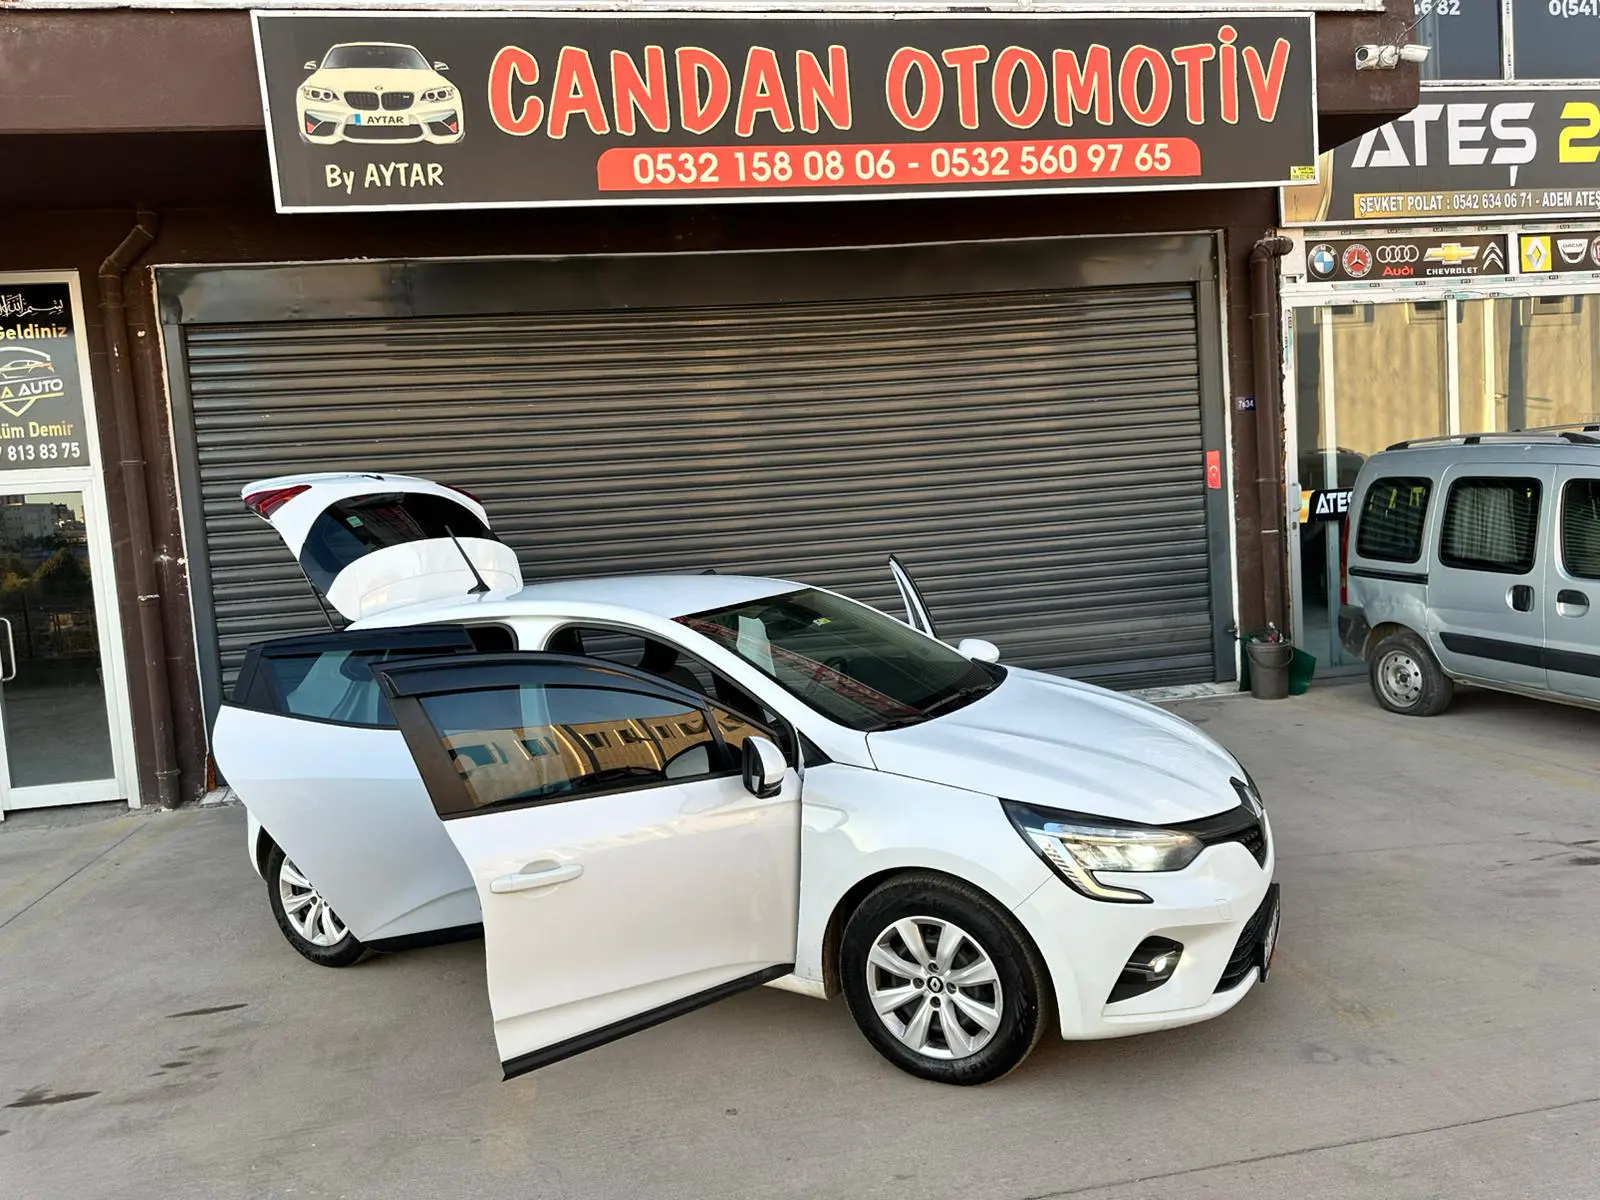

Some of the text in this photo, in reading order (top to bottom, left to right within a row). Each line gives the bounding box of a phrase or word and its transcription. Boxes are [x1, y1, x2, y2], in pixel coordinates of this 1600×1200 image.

[1437, 0, 1460, 15] 82
[1549, 0, 1600, 18] 0(541
[488, 24, 1290, 139] CANDAN OTOMOTİV
[366, 115, 404, 124] AYTAR
[1351, 102, 1537, 187] ATEŞ
[633, 153, 719, 184] 0532
[735, 151, 792, 182] 158
[803, 149, 844, 181] 08
[855, 148, 896, 180] 06
[930, 146, 1009, 178] 0532
[1020, 144, 1078, 176] 560
[1088, 143, 1123, 173] 97
[1135, 143, 1171, 172] 65
[325, 162, 444, 194] By AYTAR
[1359, 196, 1404, 217] ŞEVKET
[1407, 195, 1443, 211] POLAT
[1453, 194, 1480, 210] 0542
[1482, 194, 1503, 209] 634
[1504, 193, 1517, 208] 06
[1520, 193, 1532, 208] 71
[1541, 191, 1573, 207] ADEM
[1426, 266, 1478, 276] CHEVROLET
[18, 378, 64, 397] AUTO
[28, 420, 74, 437] Demir
[7, 444, 35, 461] 813
[39, 443, 58, 459] 83
[61, 442, 80, 458] 75
